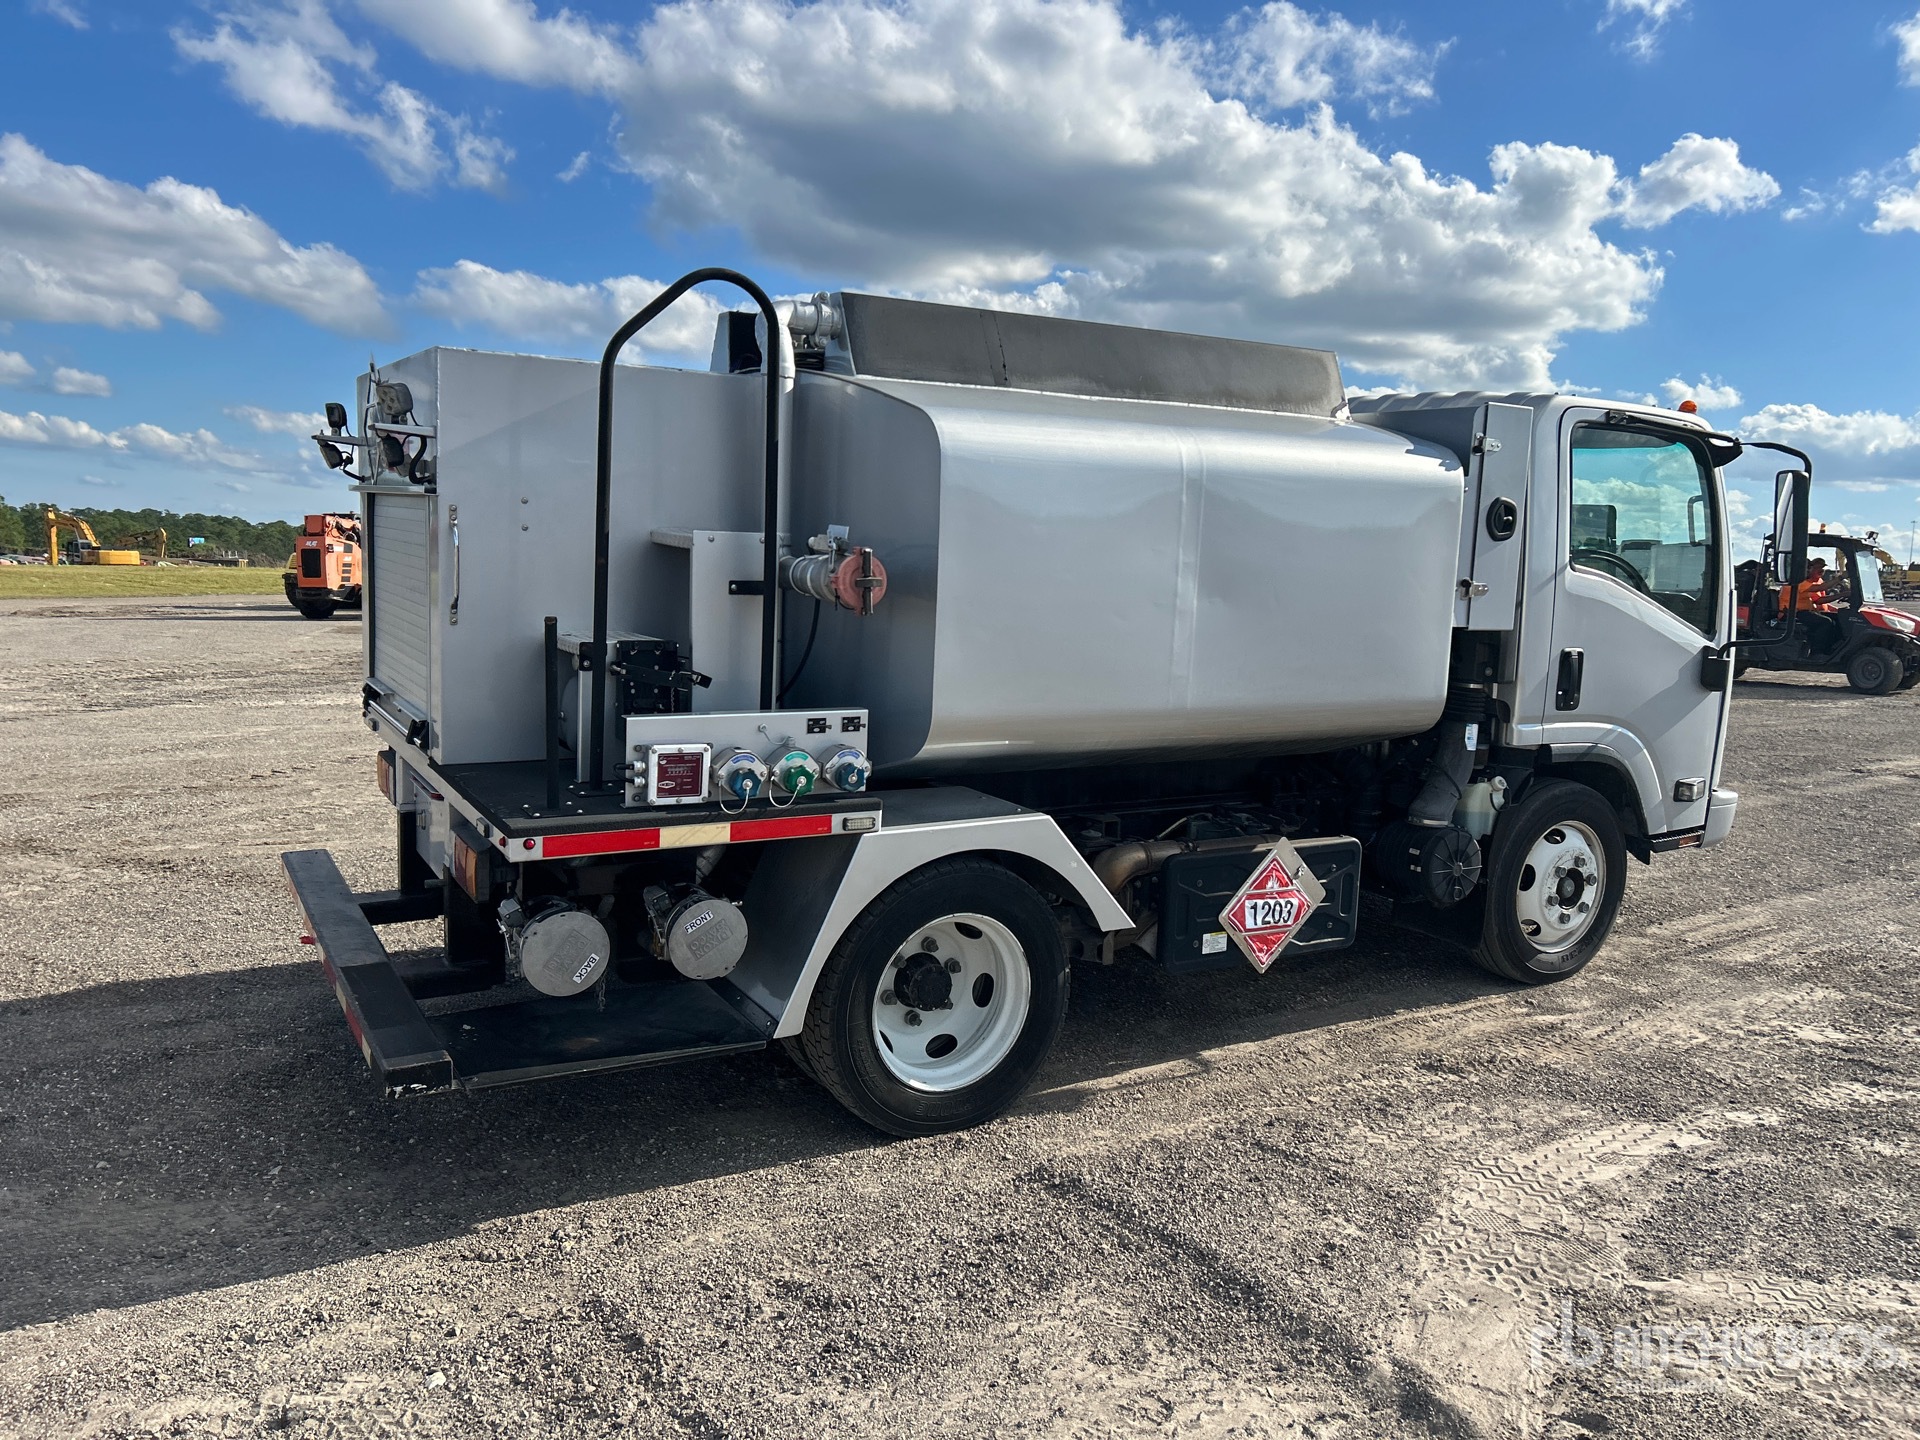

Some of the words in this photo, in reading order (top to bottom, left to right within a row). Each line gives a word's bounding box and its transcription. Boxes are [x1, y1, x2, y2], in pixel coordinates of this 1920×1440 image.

[684, 911, 713, 933] FRONT
[1249, 899, 1294, 926] 1203
[575, 956, 597, 980] BACK
